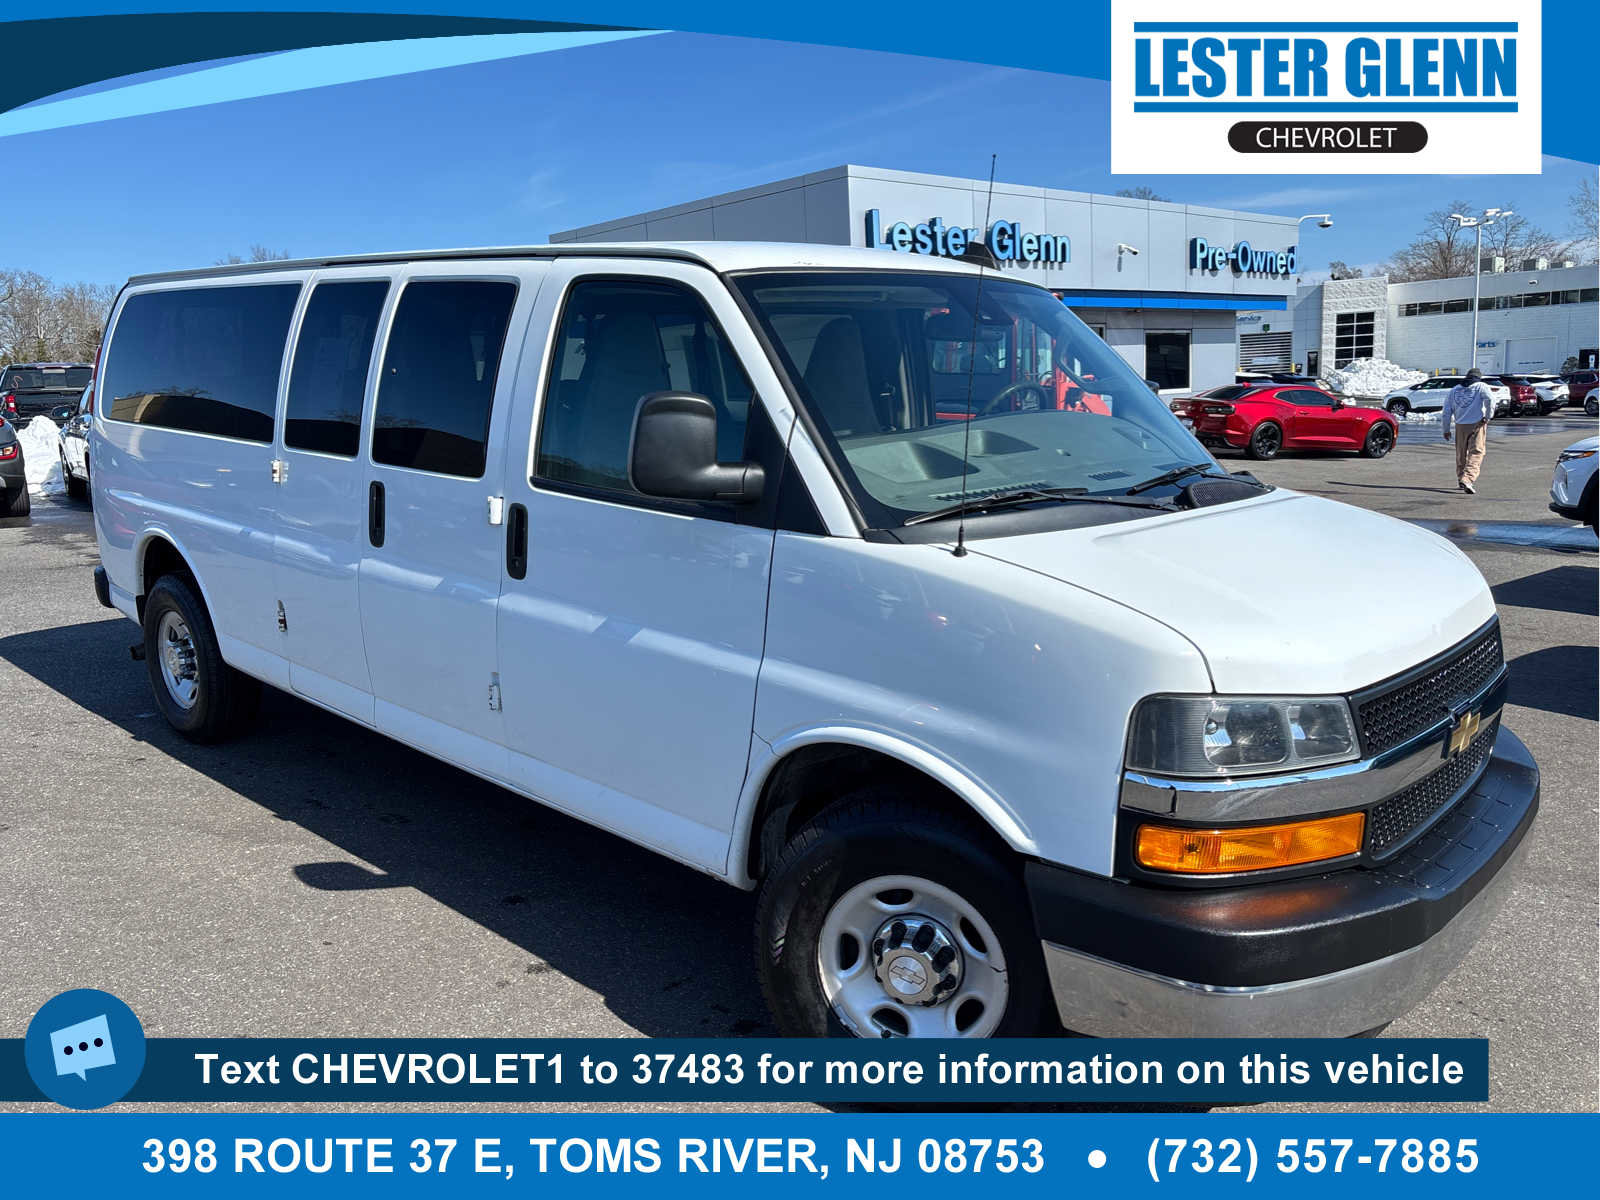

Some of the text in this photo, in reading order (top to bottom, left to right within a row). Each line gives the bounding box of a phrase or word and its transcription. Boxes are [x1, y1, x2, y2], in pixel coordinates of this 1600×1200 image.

[865, 208, 1071, 263] Lester Glenn
[1190, 237, 1297, 274] Pre-Owned
